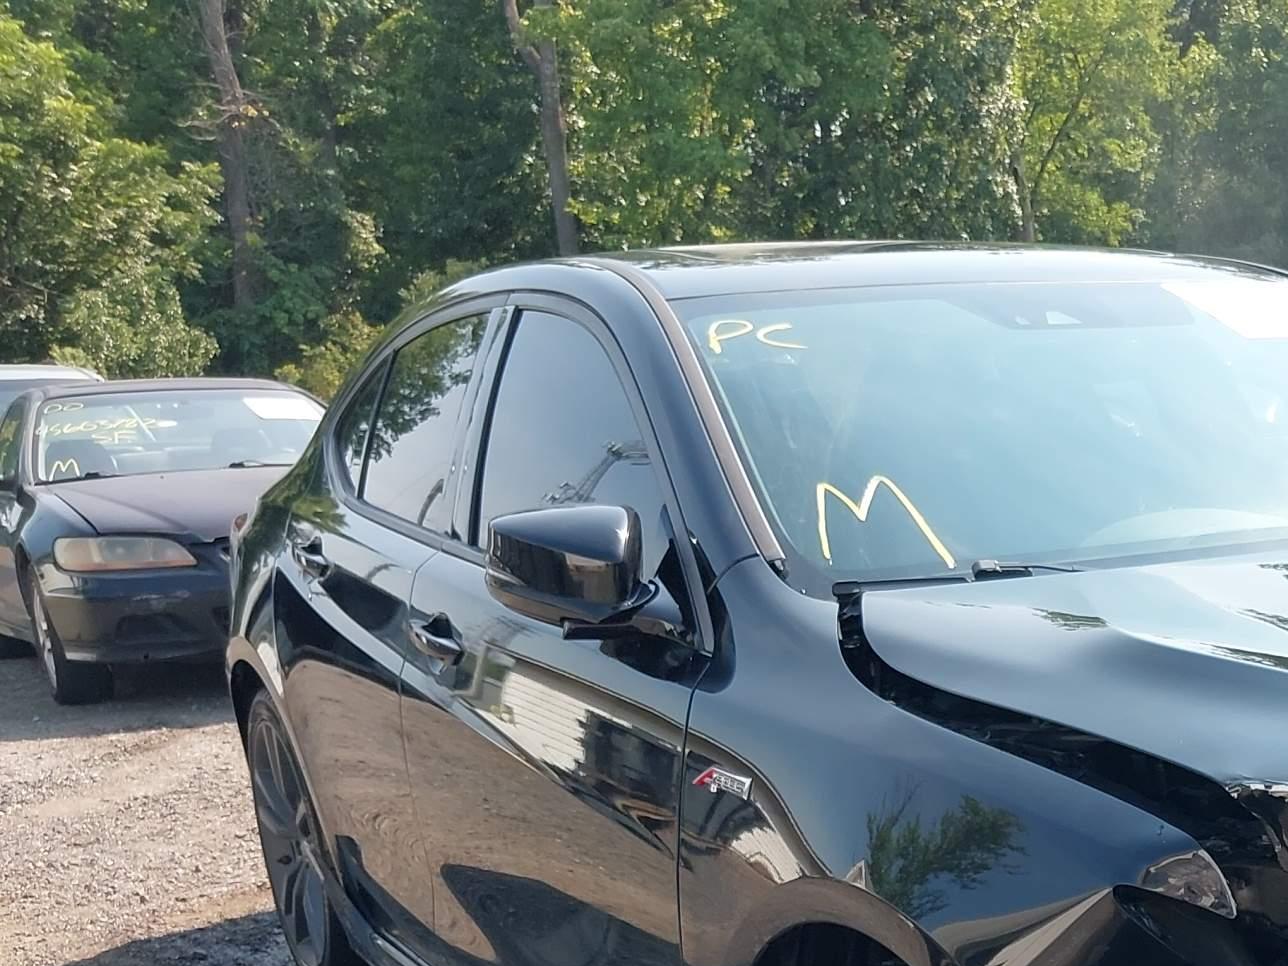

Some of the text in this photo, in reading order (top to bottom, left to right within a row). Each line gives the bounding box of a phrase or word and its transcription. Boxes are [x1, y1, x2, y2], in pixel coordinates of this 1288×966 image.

[708, 319, 808, 354] PC
[49, 458, 80, 481] M
[816, 475, 956, 569] M
